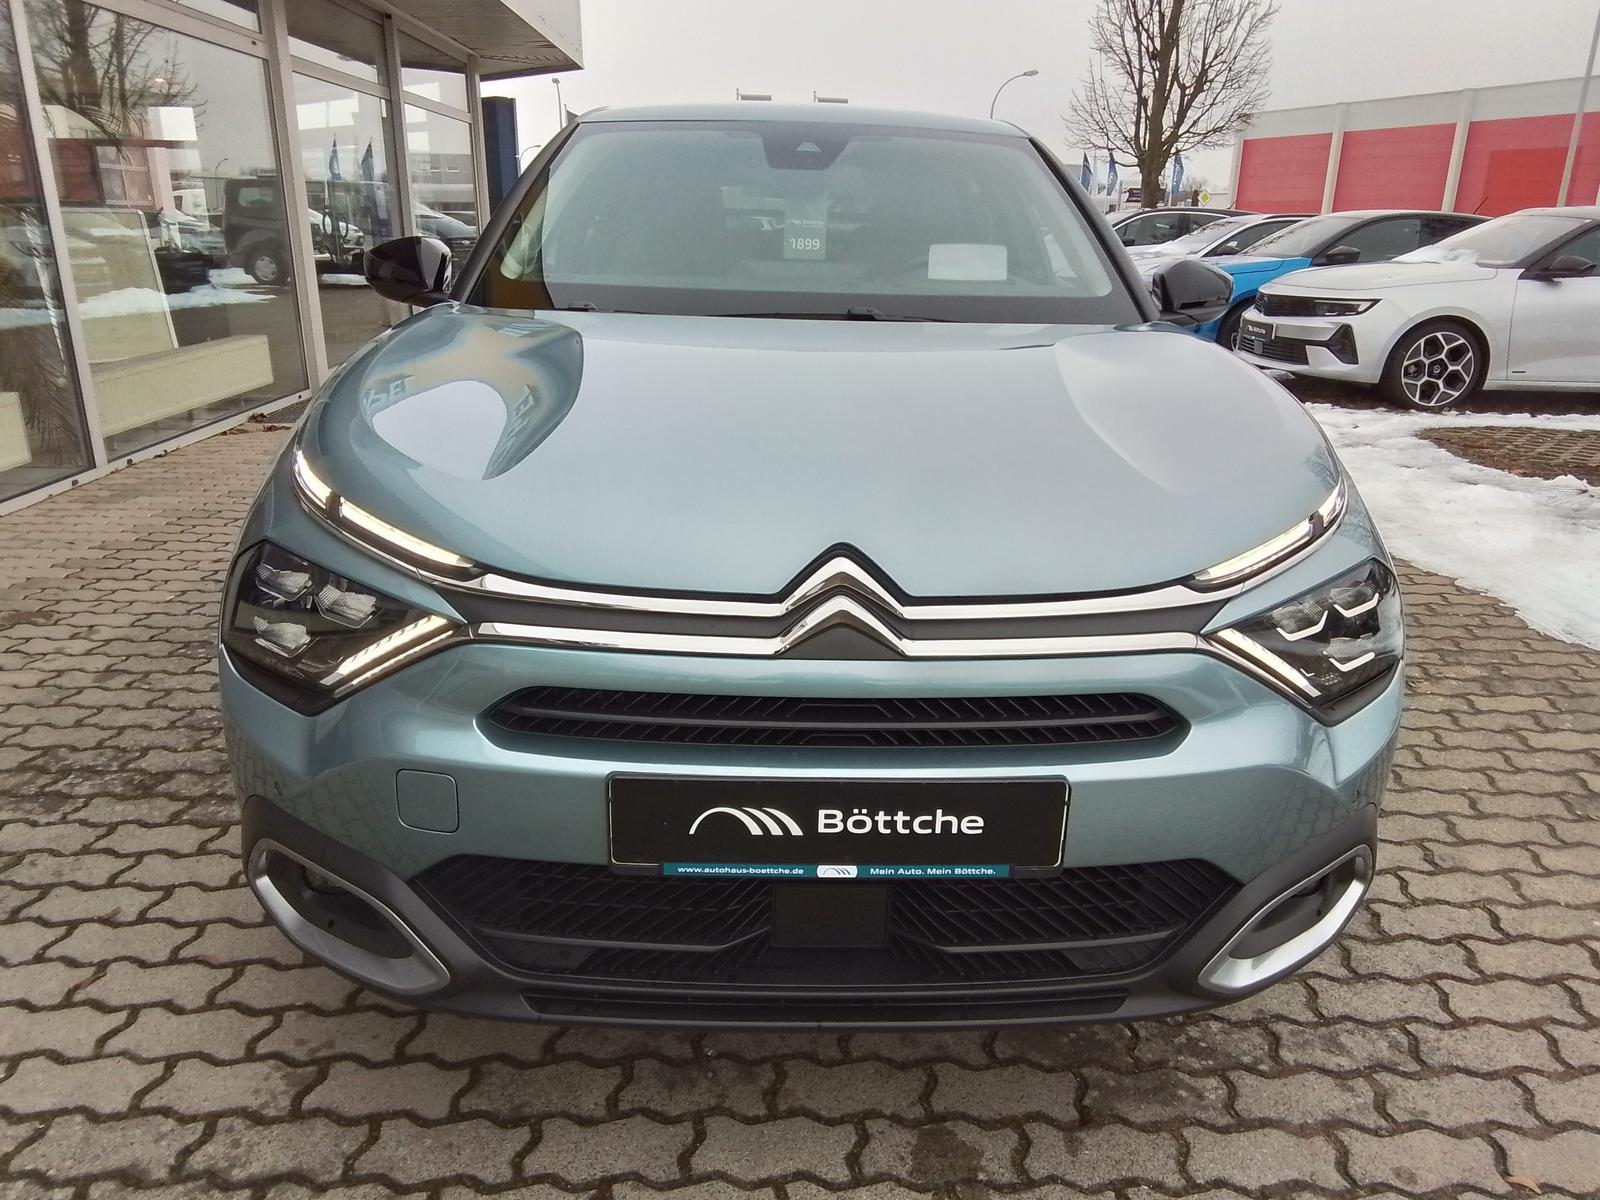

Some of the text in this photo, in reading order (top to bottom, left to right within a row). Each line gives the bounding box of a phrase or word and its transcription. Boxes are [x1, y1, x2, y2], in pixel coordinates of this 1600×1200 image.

[790, 238, 820, 250] 1899
[817, 807, 985, 835] Böttche
[677, 866, 804, 875] www.autohaus-boettche.de
[870, 866, 997, 875] Mein Auto. Mein Böttche.
